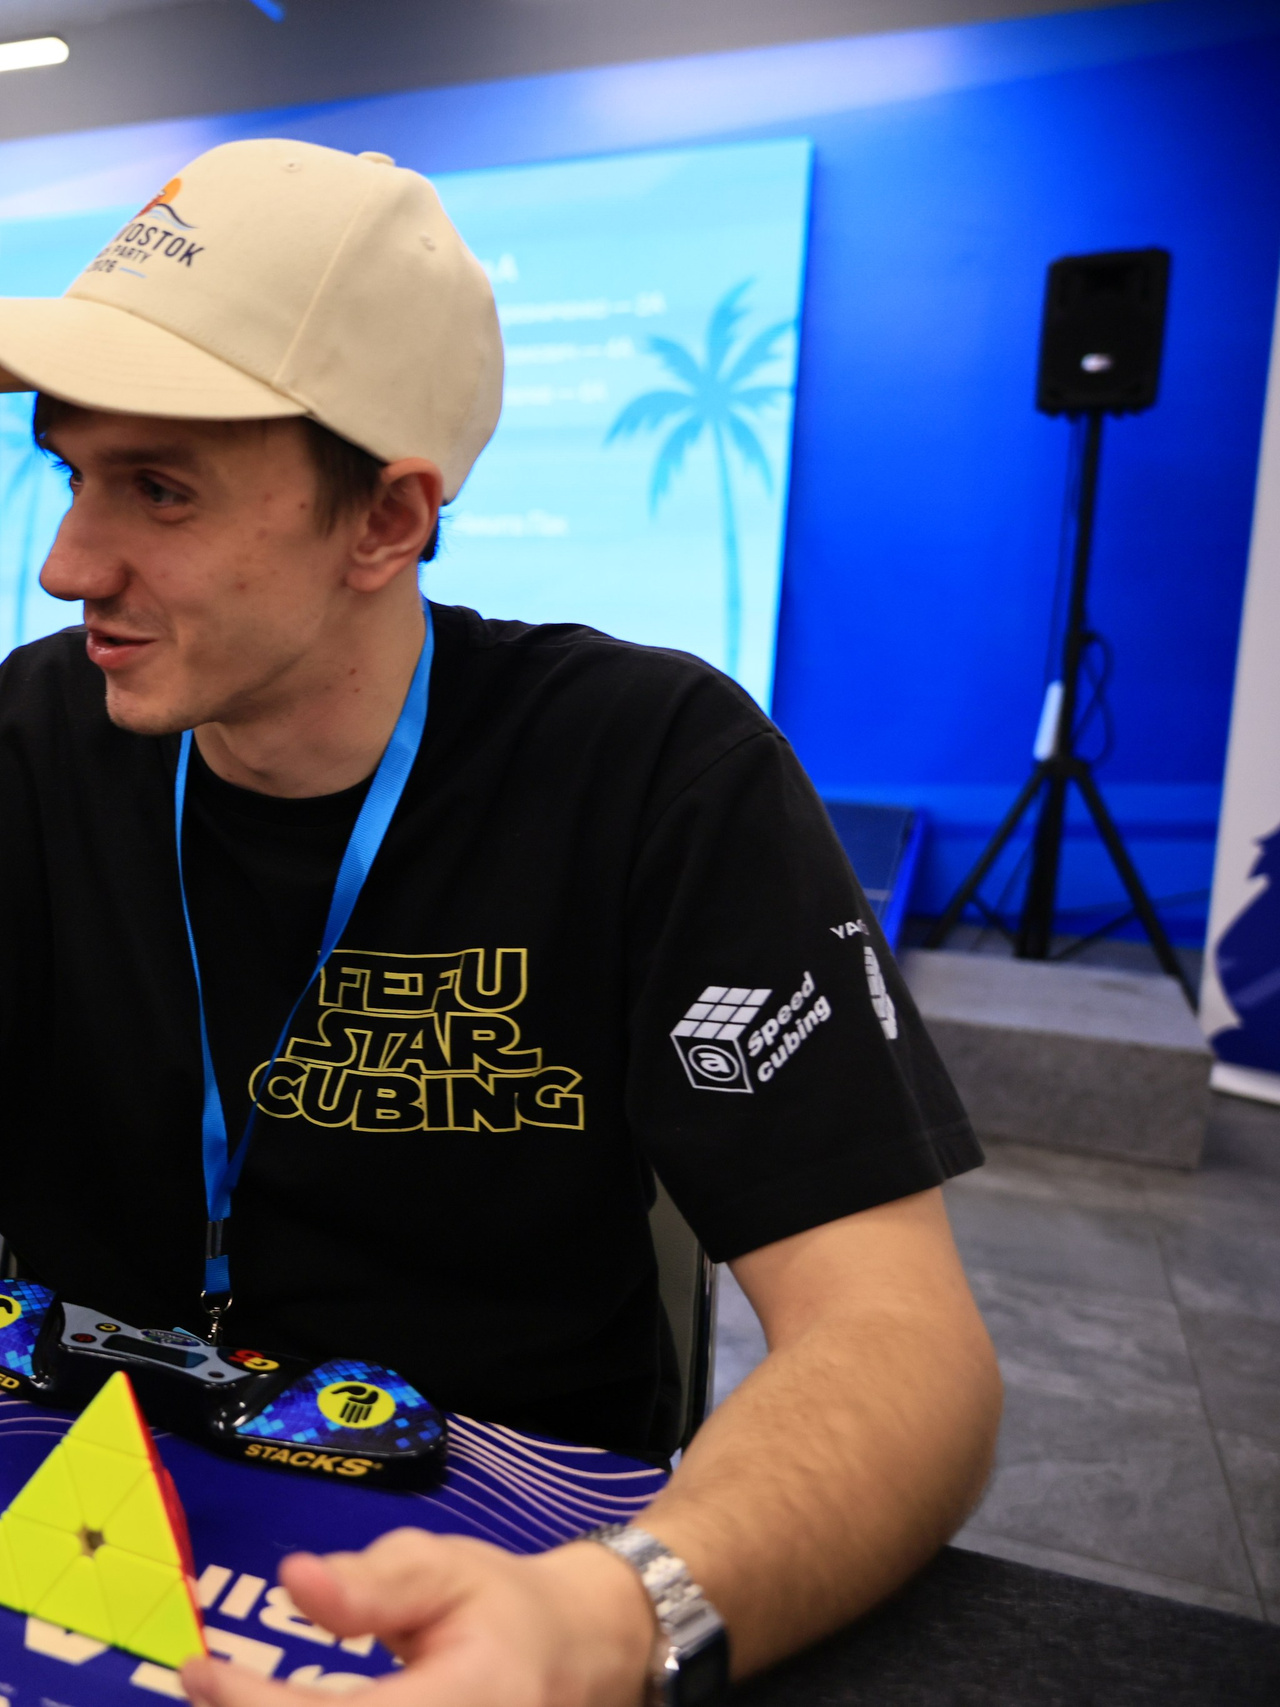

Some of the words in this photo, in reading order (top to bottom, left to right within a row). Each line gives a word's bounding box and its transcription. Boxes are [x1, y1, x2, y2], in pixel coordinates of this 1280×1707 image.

[317, 947, 528, 1014] FEFU
[285, 1007, 542, 1075] STAR
[756, 995, 832, 1083] cubing
[248, 1057, 585, 1132] CUBING
[244, 1443, 374, 1477] STACKS
